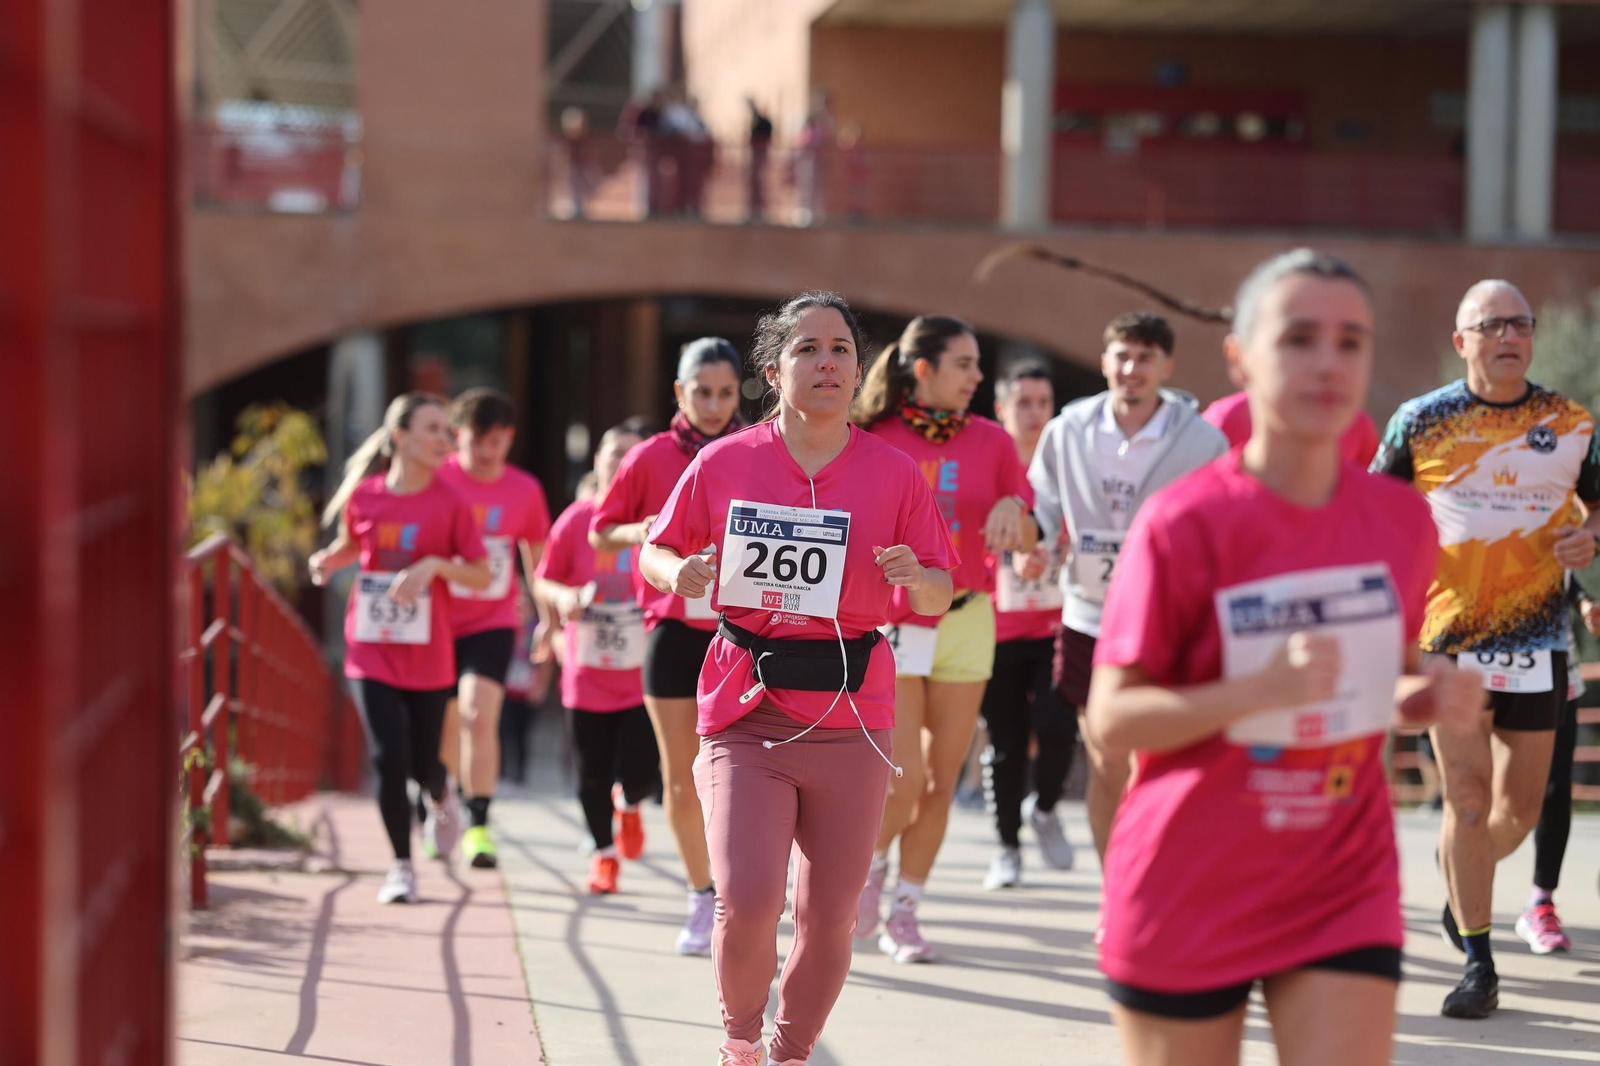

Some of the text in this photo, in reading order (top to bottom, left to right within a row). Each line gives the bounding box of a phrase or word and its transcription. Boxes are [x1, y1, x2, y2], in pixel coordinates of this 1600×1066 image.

[759, 513, 791, 521] UNIVERSIDAD
[733, 519, 785, 537] UMA
[743, 541, 827, 585] 260
[763, 594, 782, 605] WE
[783, 603, 800, 611] RUN
